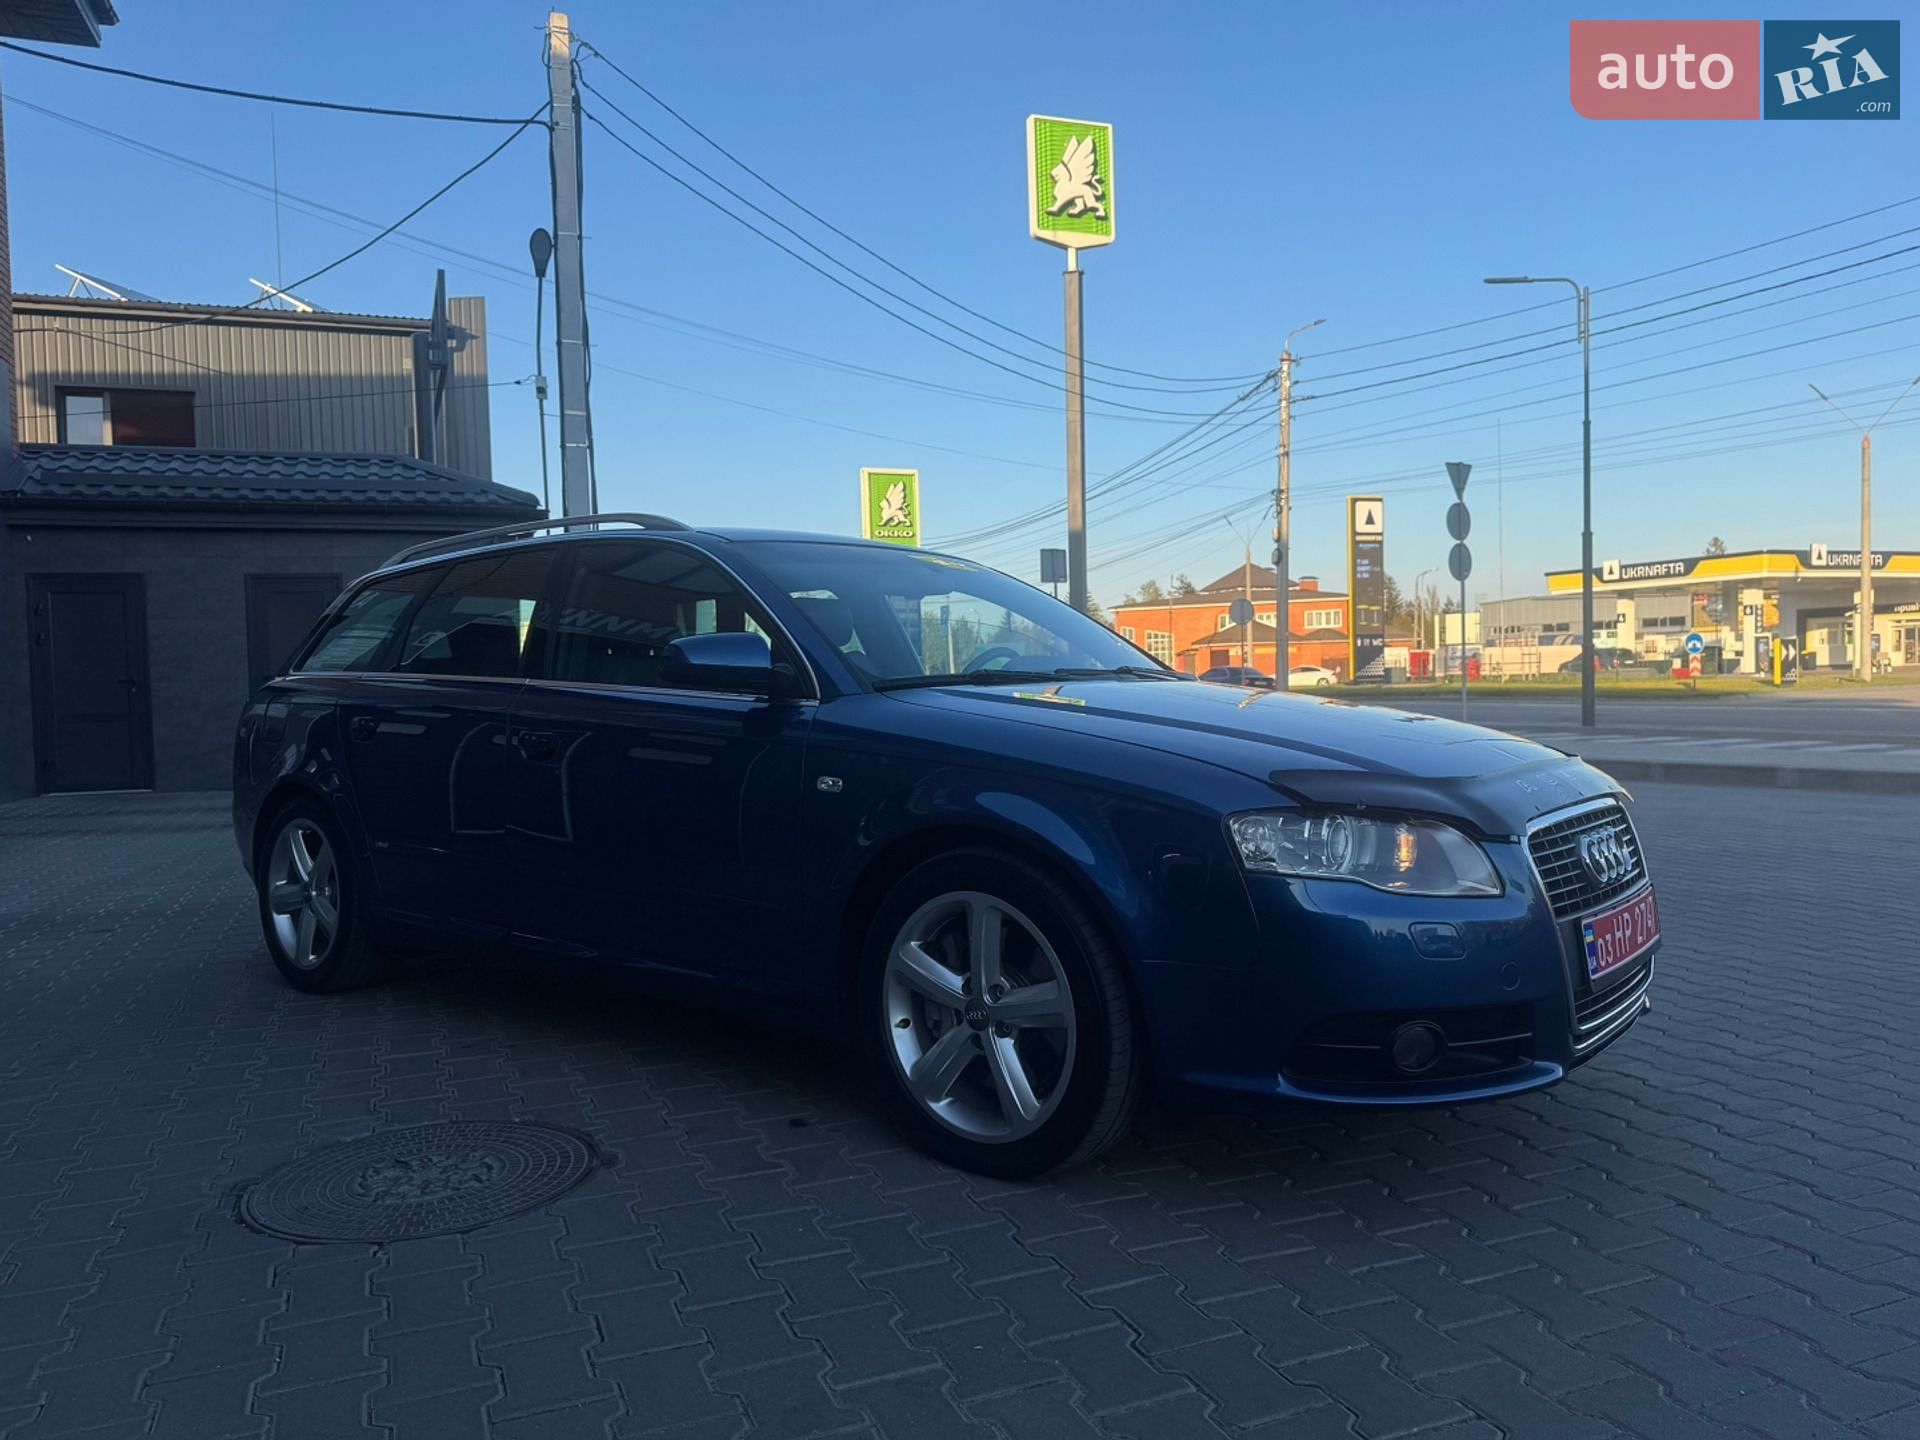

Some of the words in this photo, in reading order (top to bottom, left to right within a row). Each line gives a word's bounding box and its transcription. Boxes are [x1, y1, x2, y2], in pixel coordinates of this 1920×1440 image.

[875, 529, 913, 538] OKKO
[1828, 553, 1883, 567] UKRNATA
[1621, 562, 1684, 579] UKRNAFTA
[1597, 933, 1613, 967] 03
[1613, 912, 1632, 957] HP
